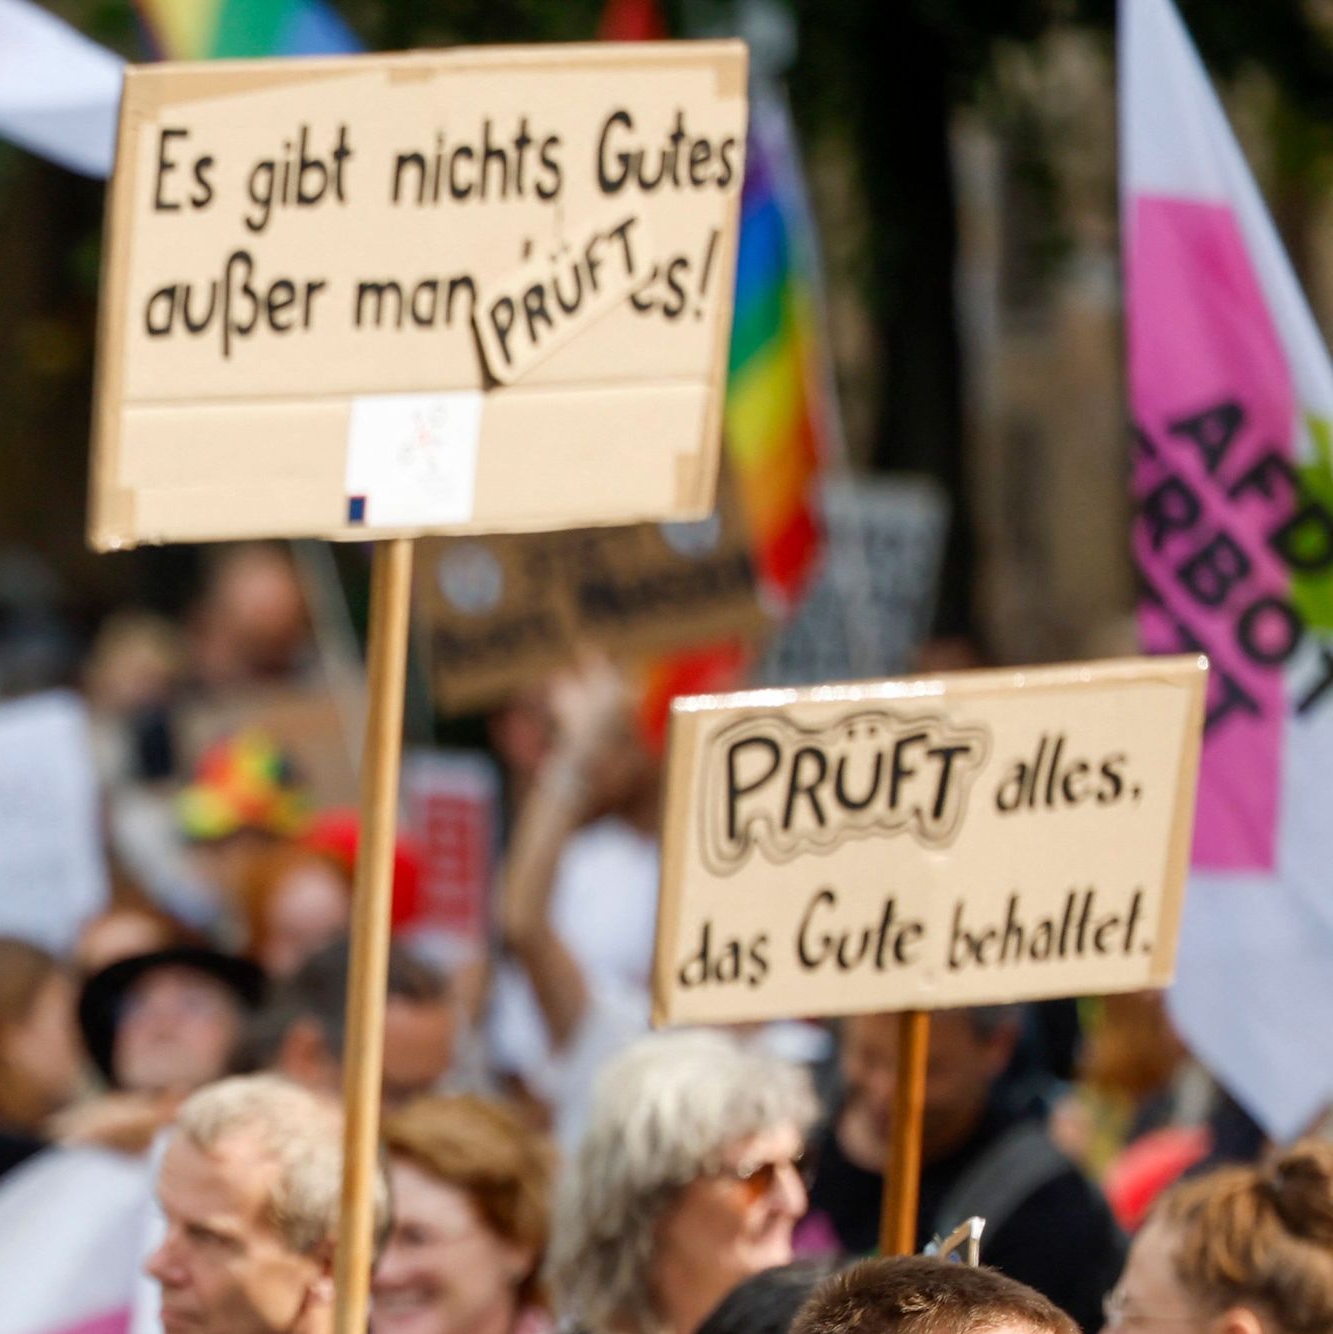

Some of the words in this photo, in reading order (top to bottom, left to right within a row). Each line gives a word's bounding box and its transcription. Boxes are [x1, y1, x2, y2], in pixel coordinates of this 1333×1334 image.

[151, 128, 214, 213] Es
[245, 122, 355, 234] gibt
[390, 116, 563, 204] nichts
[595, 109, 735, 196] Gutes
[144, 248, 326, 360] außer
[352, 273, 477, 330] man
[488, 216, 640, 367] PRÜFT
[726, 722, 973, 842] PRÜFT
[995, 732, 1143, 816] alles.
[677, 918, 770, 990] das
[796, 888, 924, 972] Gute
